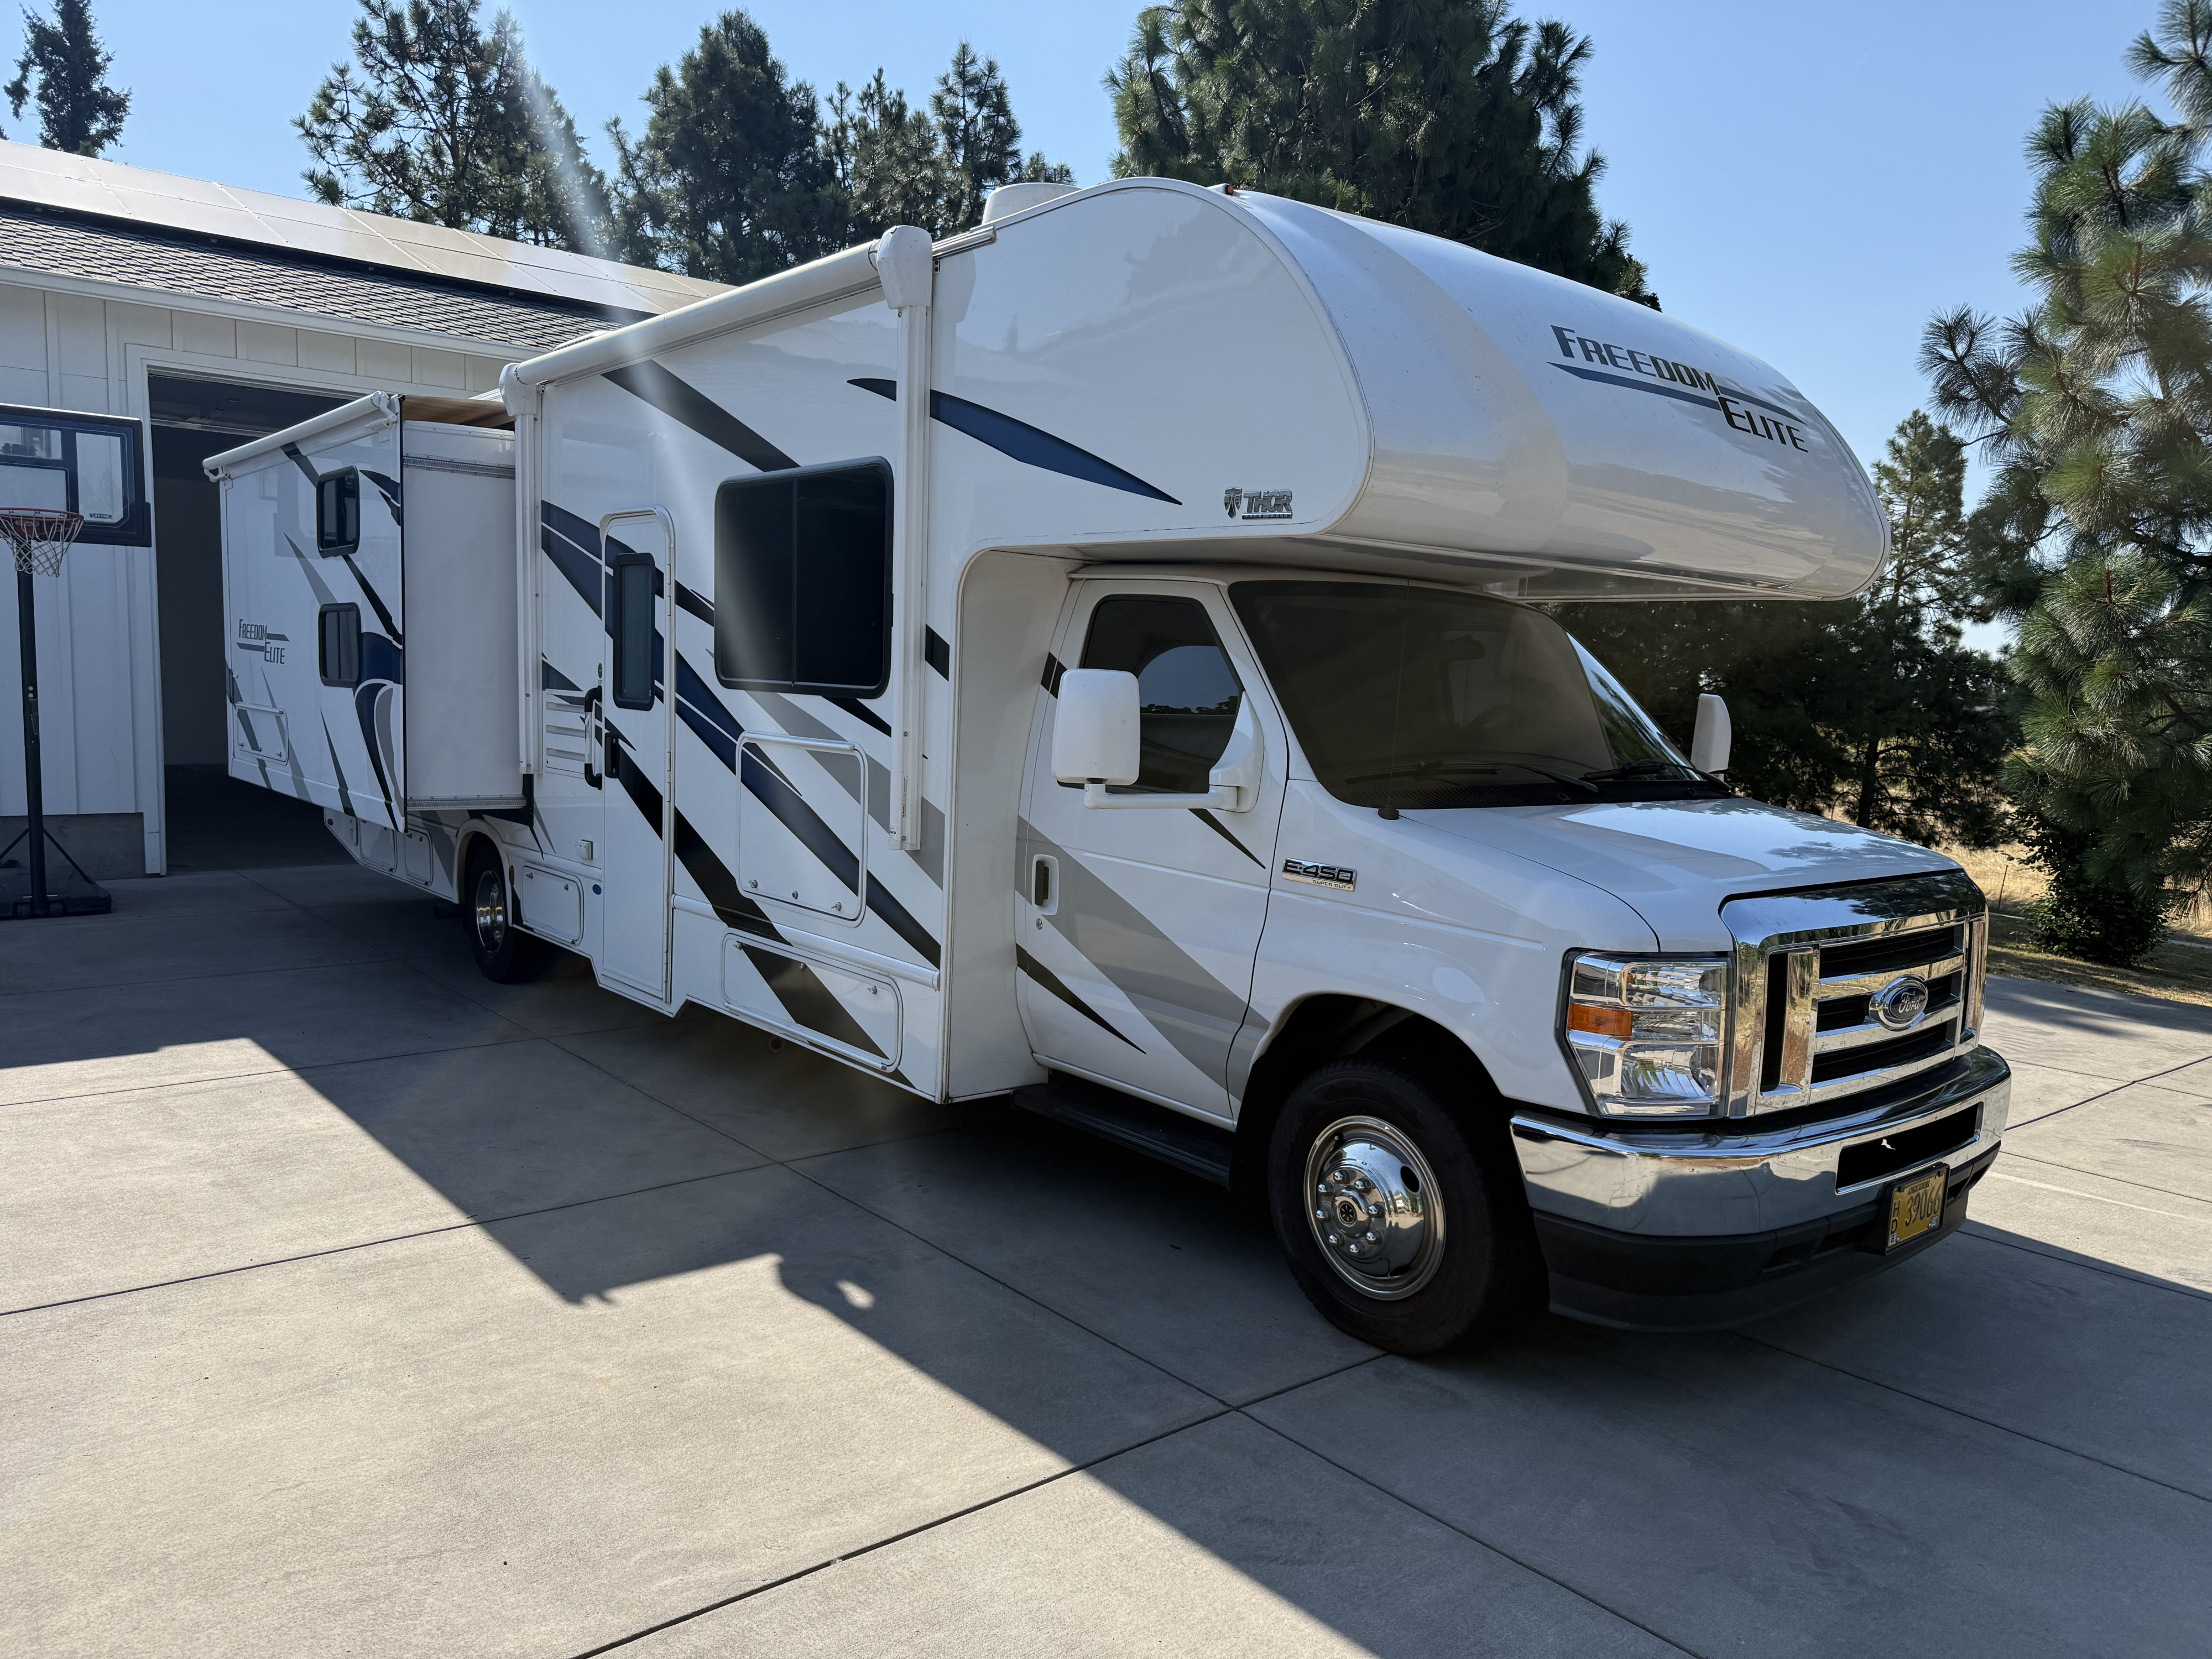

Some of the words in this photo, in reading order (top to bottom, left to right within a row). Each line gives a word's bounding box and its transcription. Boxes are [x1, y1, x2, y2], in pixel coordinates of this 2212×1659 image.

[1551, 325, 1720, 397] FREEDOM
[1718, 396, 1809, 453] ELITE
[1243, 489, 1292, 513] THOR
[239, 619, 267, 641] FREEDOM
[264, 641, 285, 664] ELITE
[1284, 860, 1354, 884] E-450
[1898, 991, 1921, 1014] Ford
